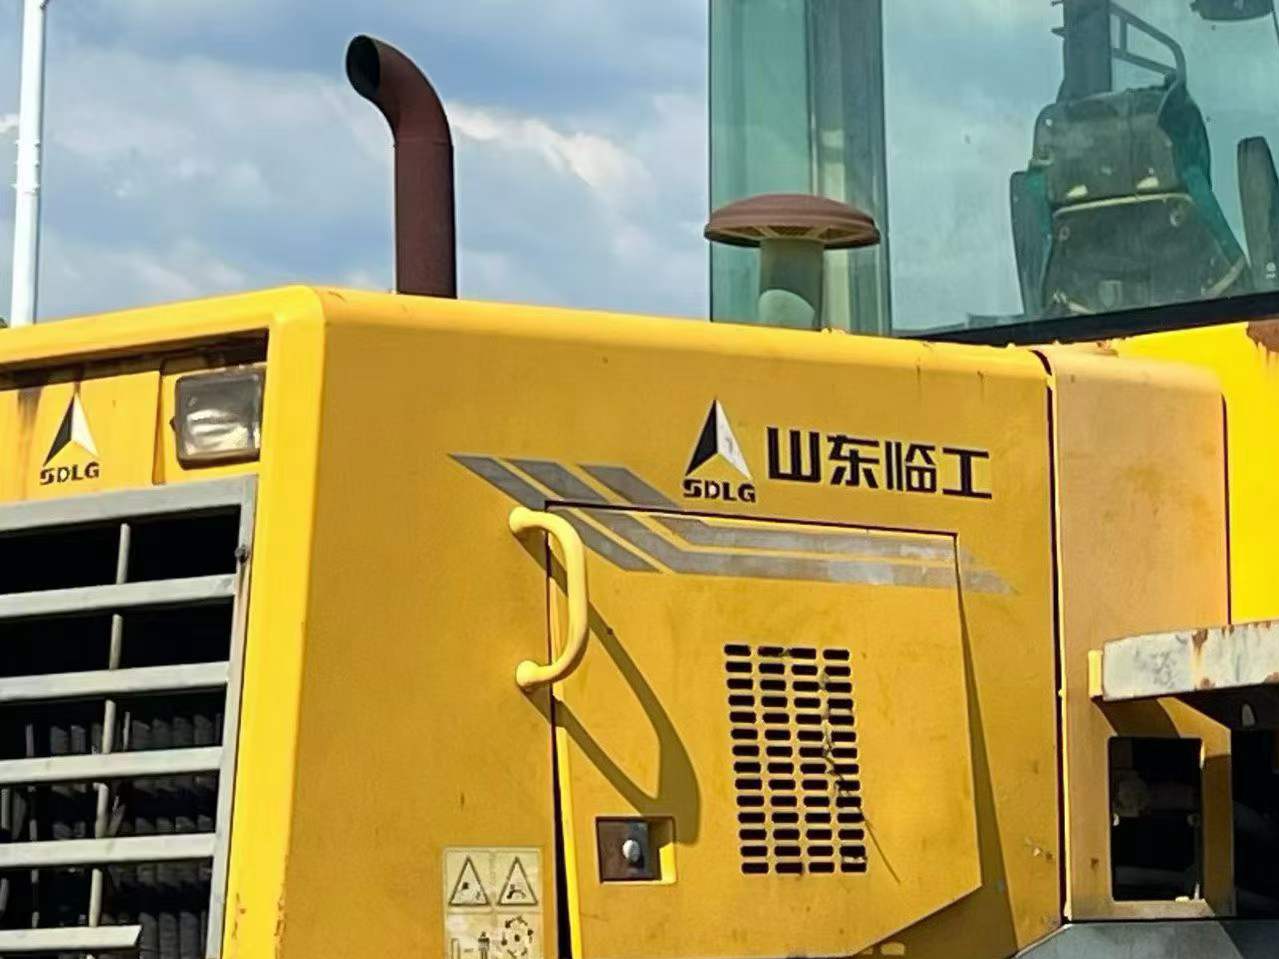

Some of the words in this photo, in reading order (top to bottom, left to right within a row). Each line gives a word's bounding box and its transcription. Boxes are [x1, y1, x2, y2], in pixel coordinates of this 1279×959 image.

[40, 462, 100, 485] SDLG
[767, 427, 993, 500] 山东临工
[683, 479, 756, 503] SDLG
